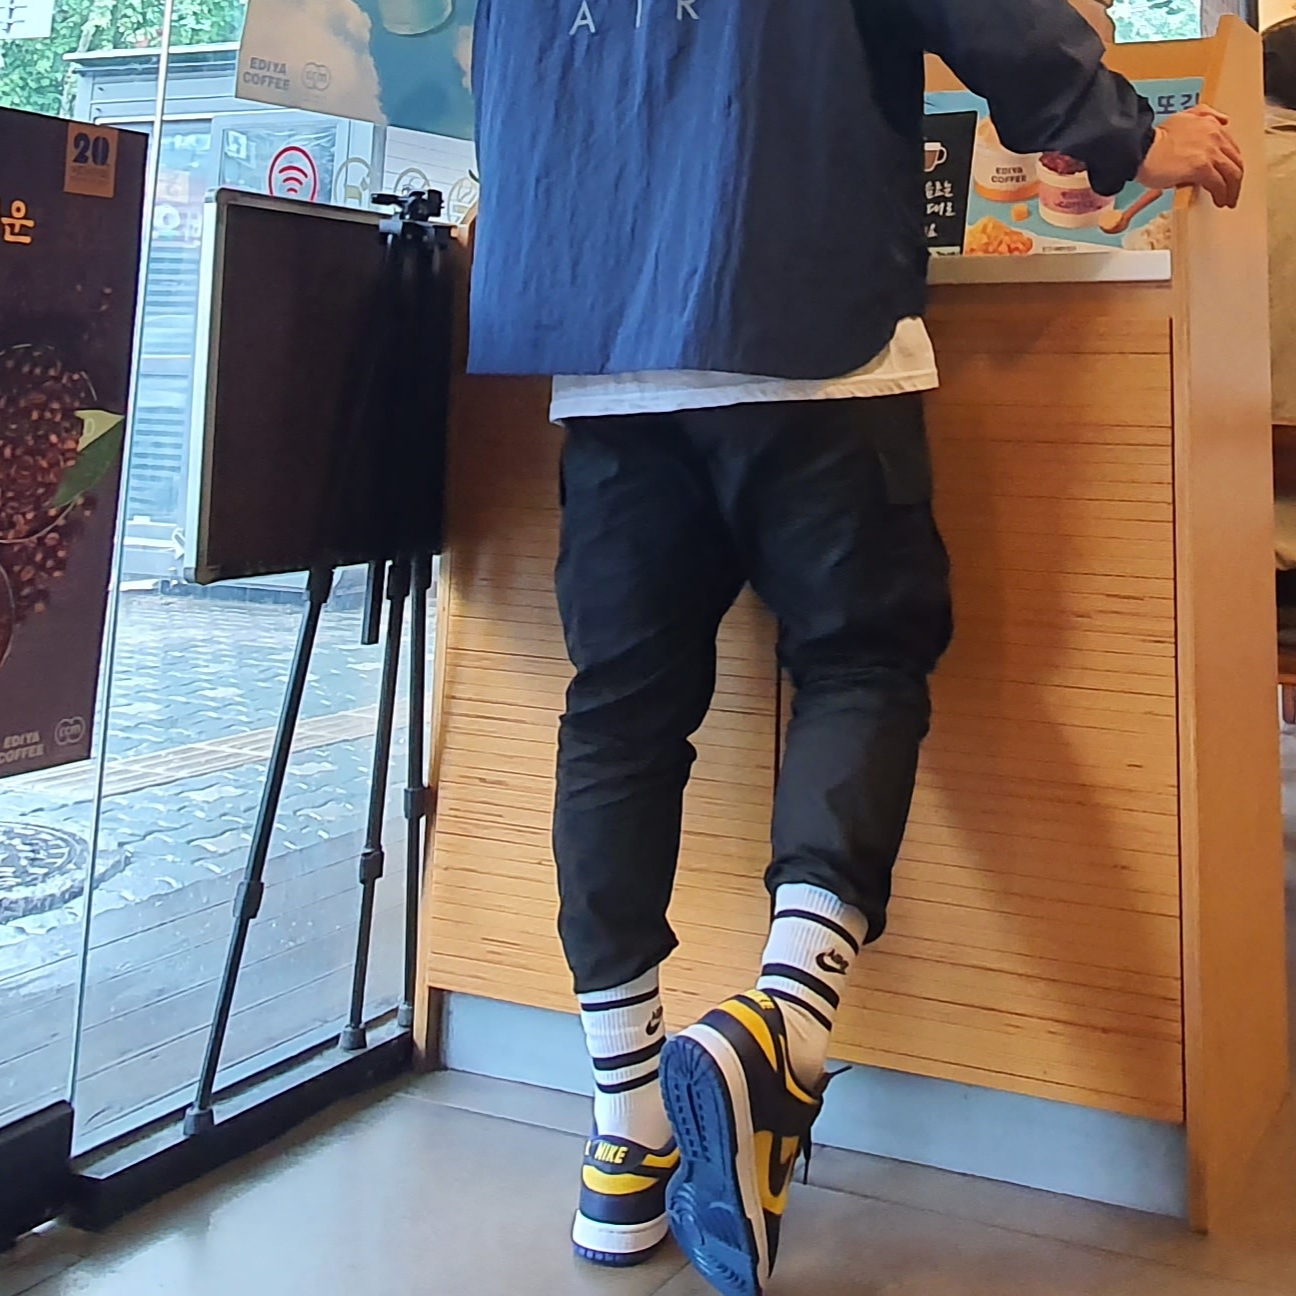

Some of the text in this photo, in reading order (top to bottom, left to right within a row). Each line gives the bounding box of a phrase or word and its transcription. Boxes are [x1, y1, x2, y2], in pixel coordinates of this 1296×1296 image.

[250, 57, 287, 74] EDIYA
[243, 71, 290, 90] COFFEE
[73, 132, 110, 165] 20
[1, 200, 35, 244] 운
[3, 731, 40, 749] EDIYA
[594, 1141, 629, 1164] NIKE
